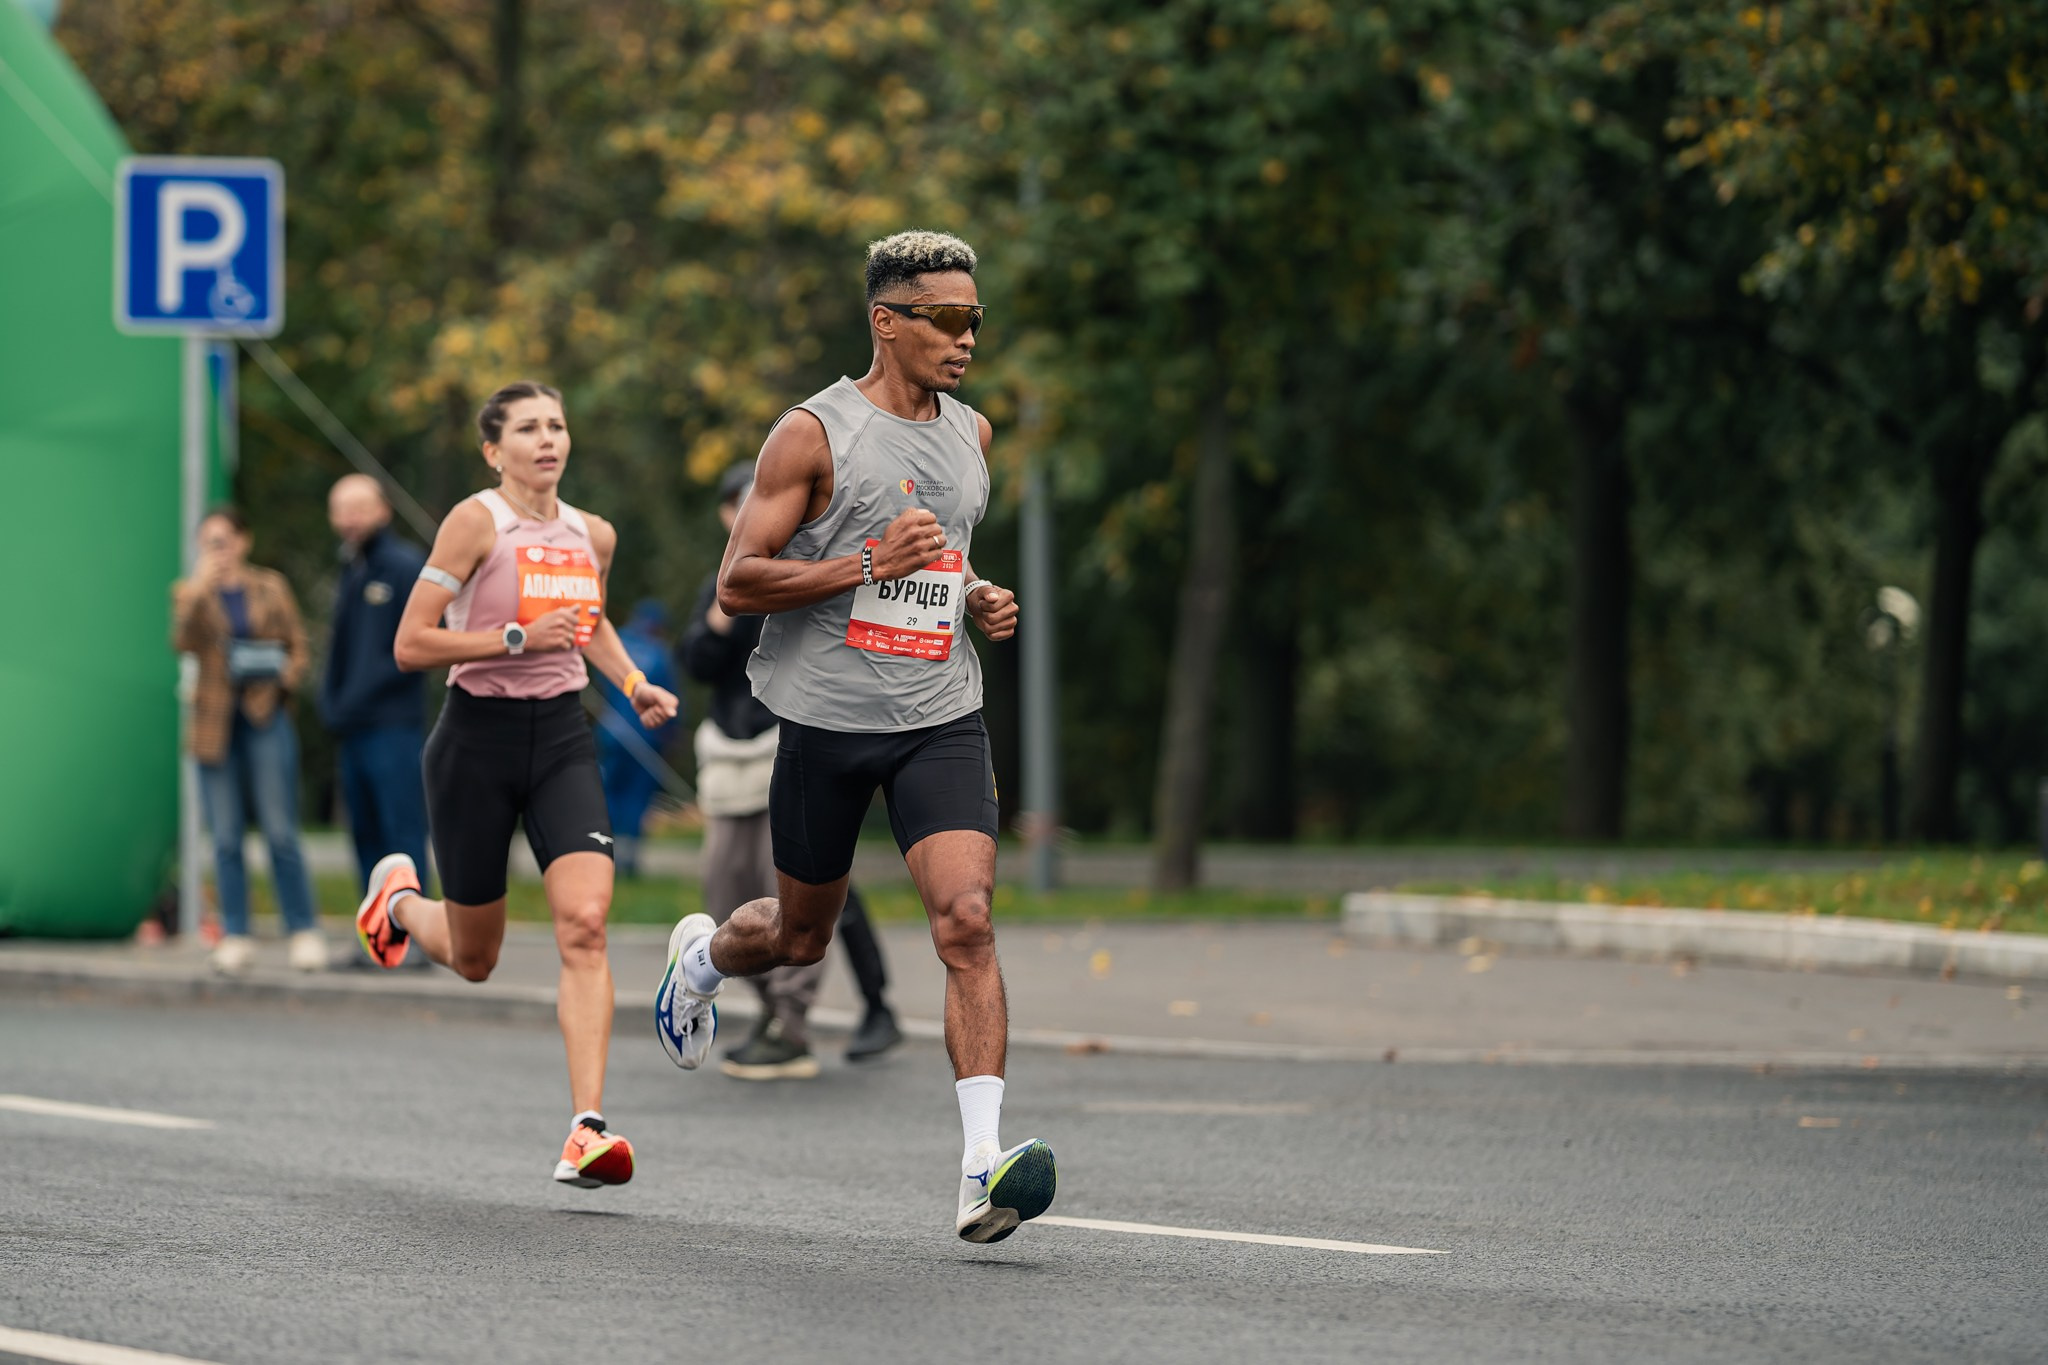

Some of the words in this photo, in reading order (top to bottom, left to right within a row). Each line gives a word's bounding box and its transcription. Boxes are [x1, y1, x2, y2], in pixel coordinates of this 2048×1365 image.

[157, 182, 246, 312] P
[878, 580, 949, 609] БУРЦЕВ
[906, 617, 918, 626] 29
